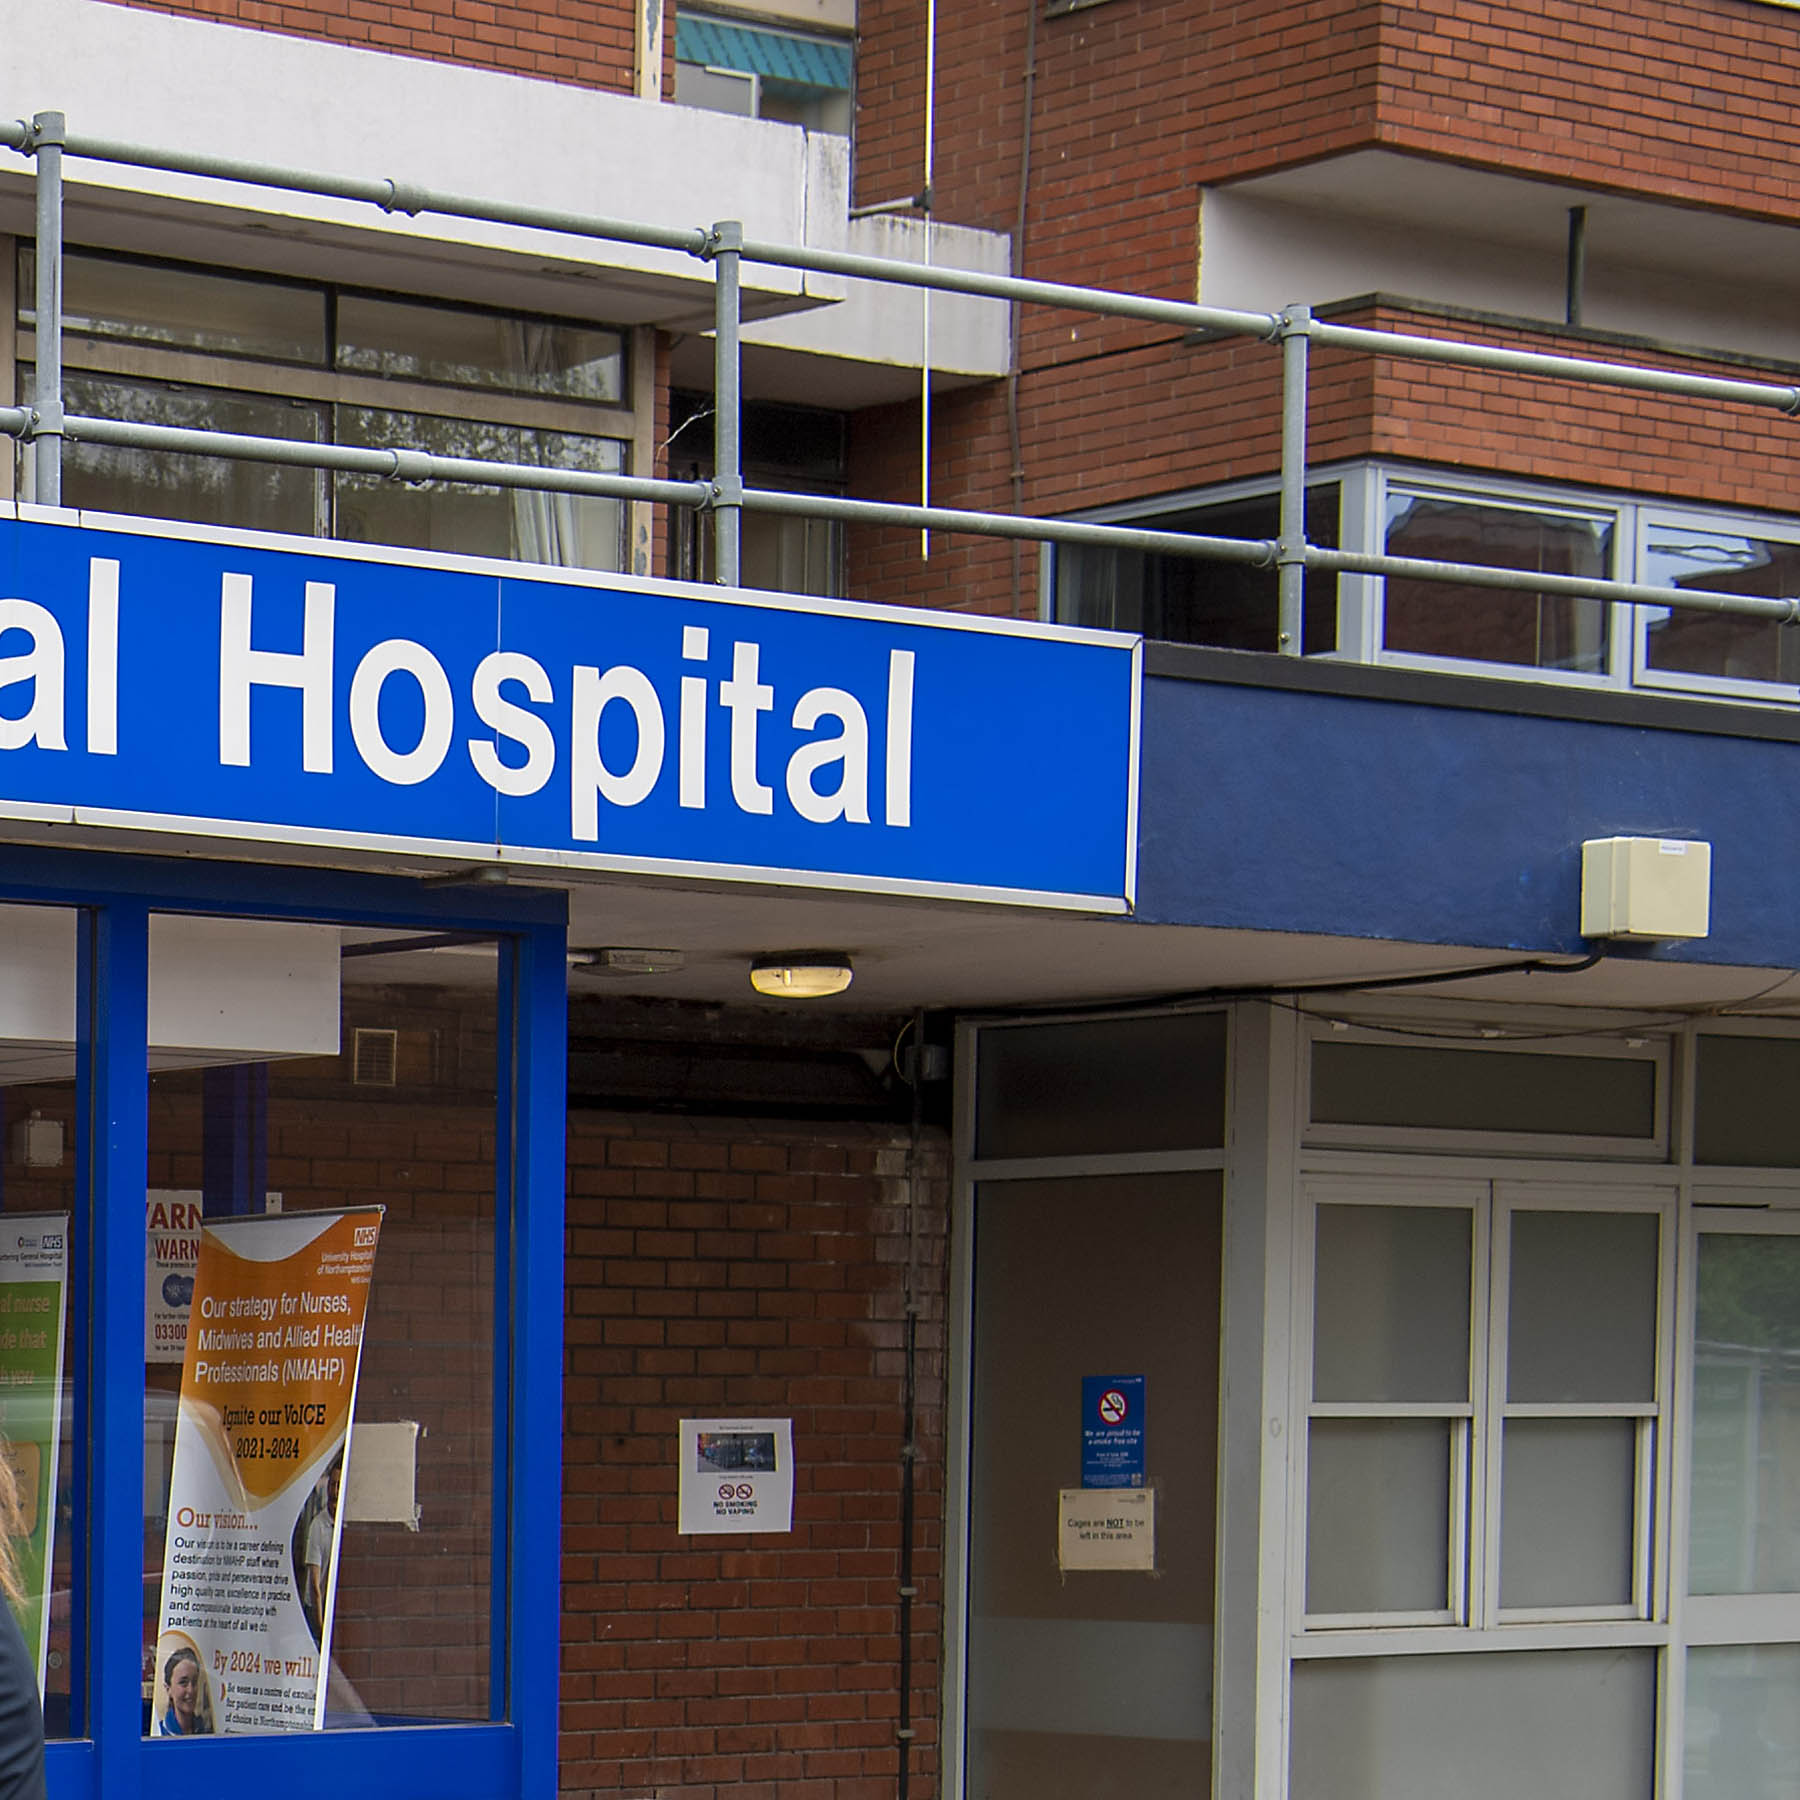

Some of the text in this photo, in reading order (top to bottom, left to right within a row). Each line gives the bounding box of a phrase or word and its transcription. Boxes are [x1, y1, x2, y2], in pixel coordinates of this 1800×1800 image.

[218, 571, 916, 841] Hospital
[354, 1227, 376, 1245] NHS
[201, 1291, 351, 1320] Our strategy for Nurses,
[198, 1328, 254, 1351] Midwives
[257, 1326, 282, 1349] and
[284, 1325, 319, 1348] Allied
[194, 1358, 345, 1386] Professionals (NMAHP)
[222, 1404, 326, 1431] Ignite our VoICE
[177, 1507, 210, 1528] Our
[1106, 1518, 1124, 1529] NOT
[213, 1650, 228, 1676] By
[230, 1651, 261, 1673] 2024
[264, 1658, 281, 1676] we
